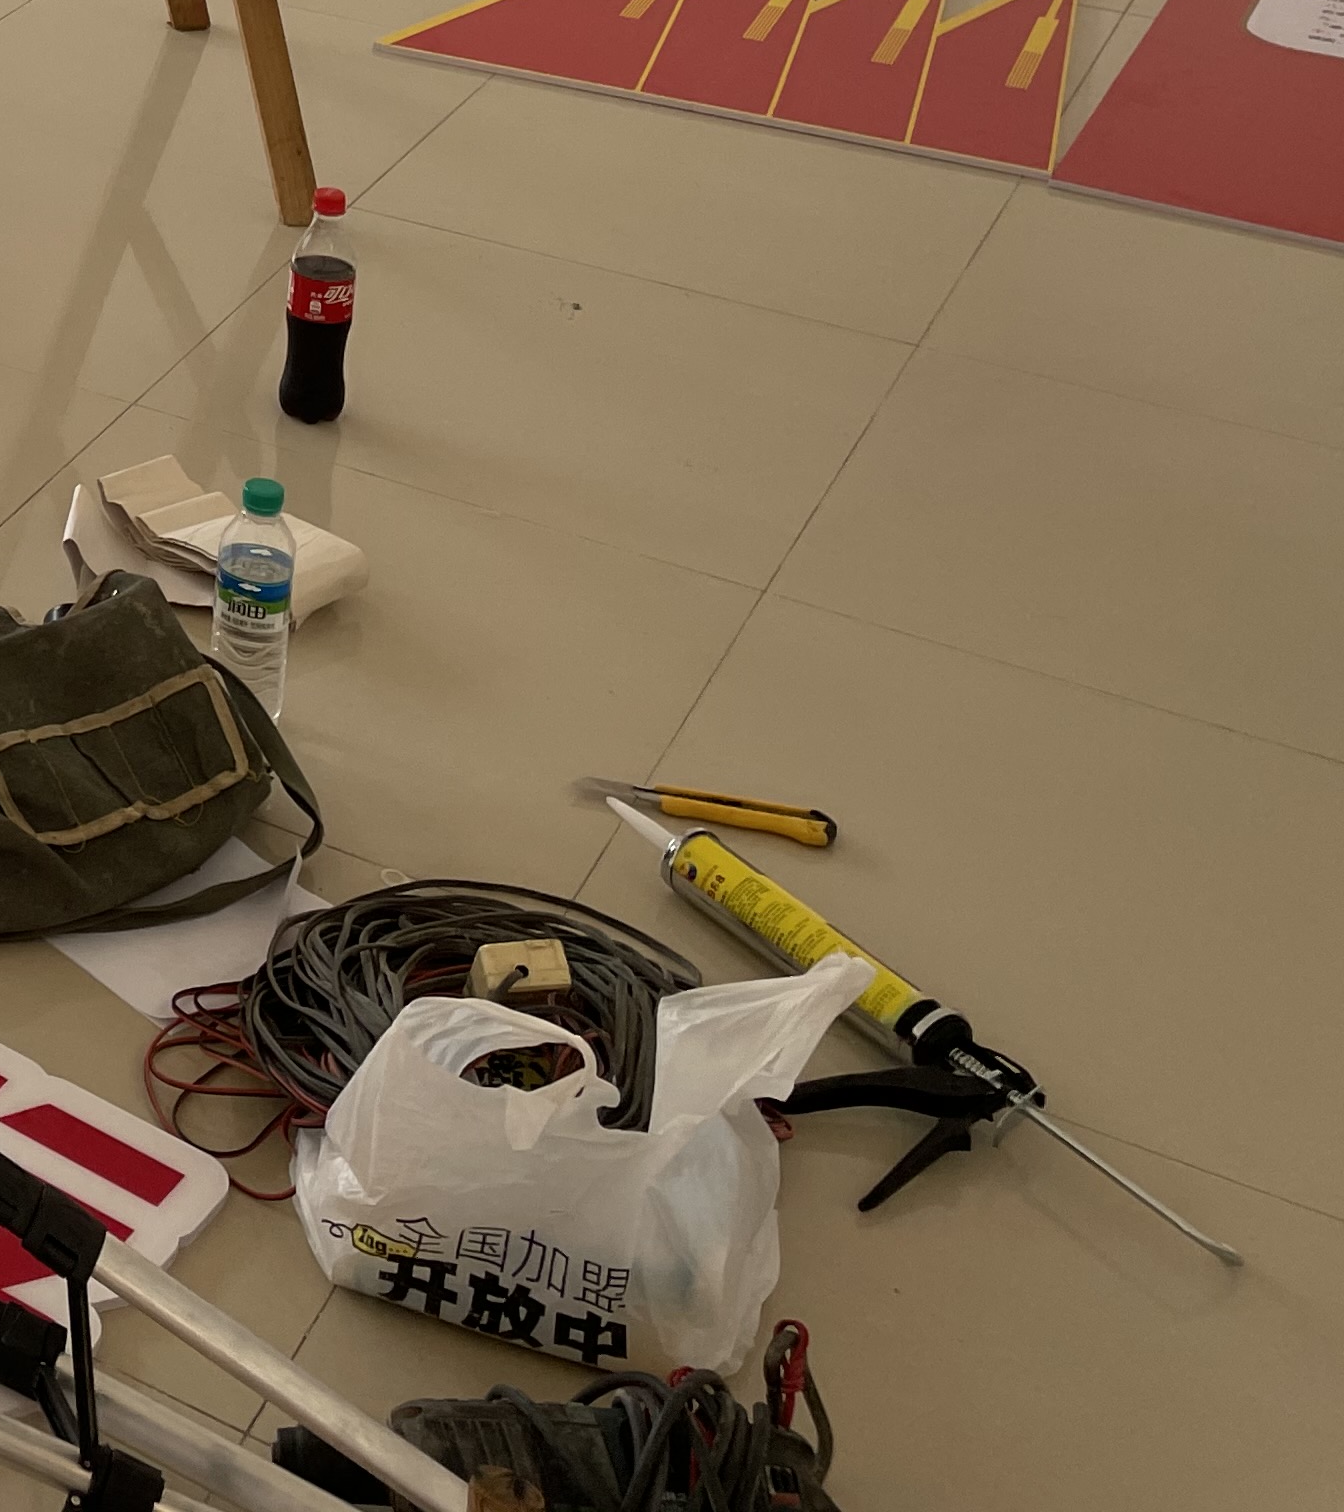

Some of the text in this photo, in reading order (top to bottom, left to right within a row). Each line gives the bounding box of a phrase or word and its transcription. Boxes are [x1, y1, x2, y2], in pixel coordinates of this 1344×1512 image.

[378, 1253, 628, 1365] 开放中
[396, 1216, 631, 1313] 全国加盟
